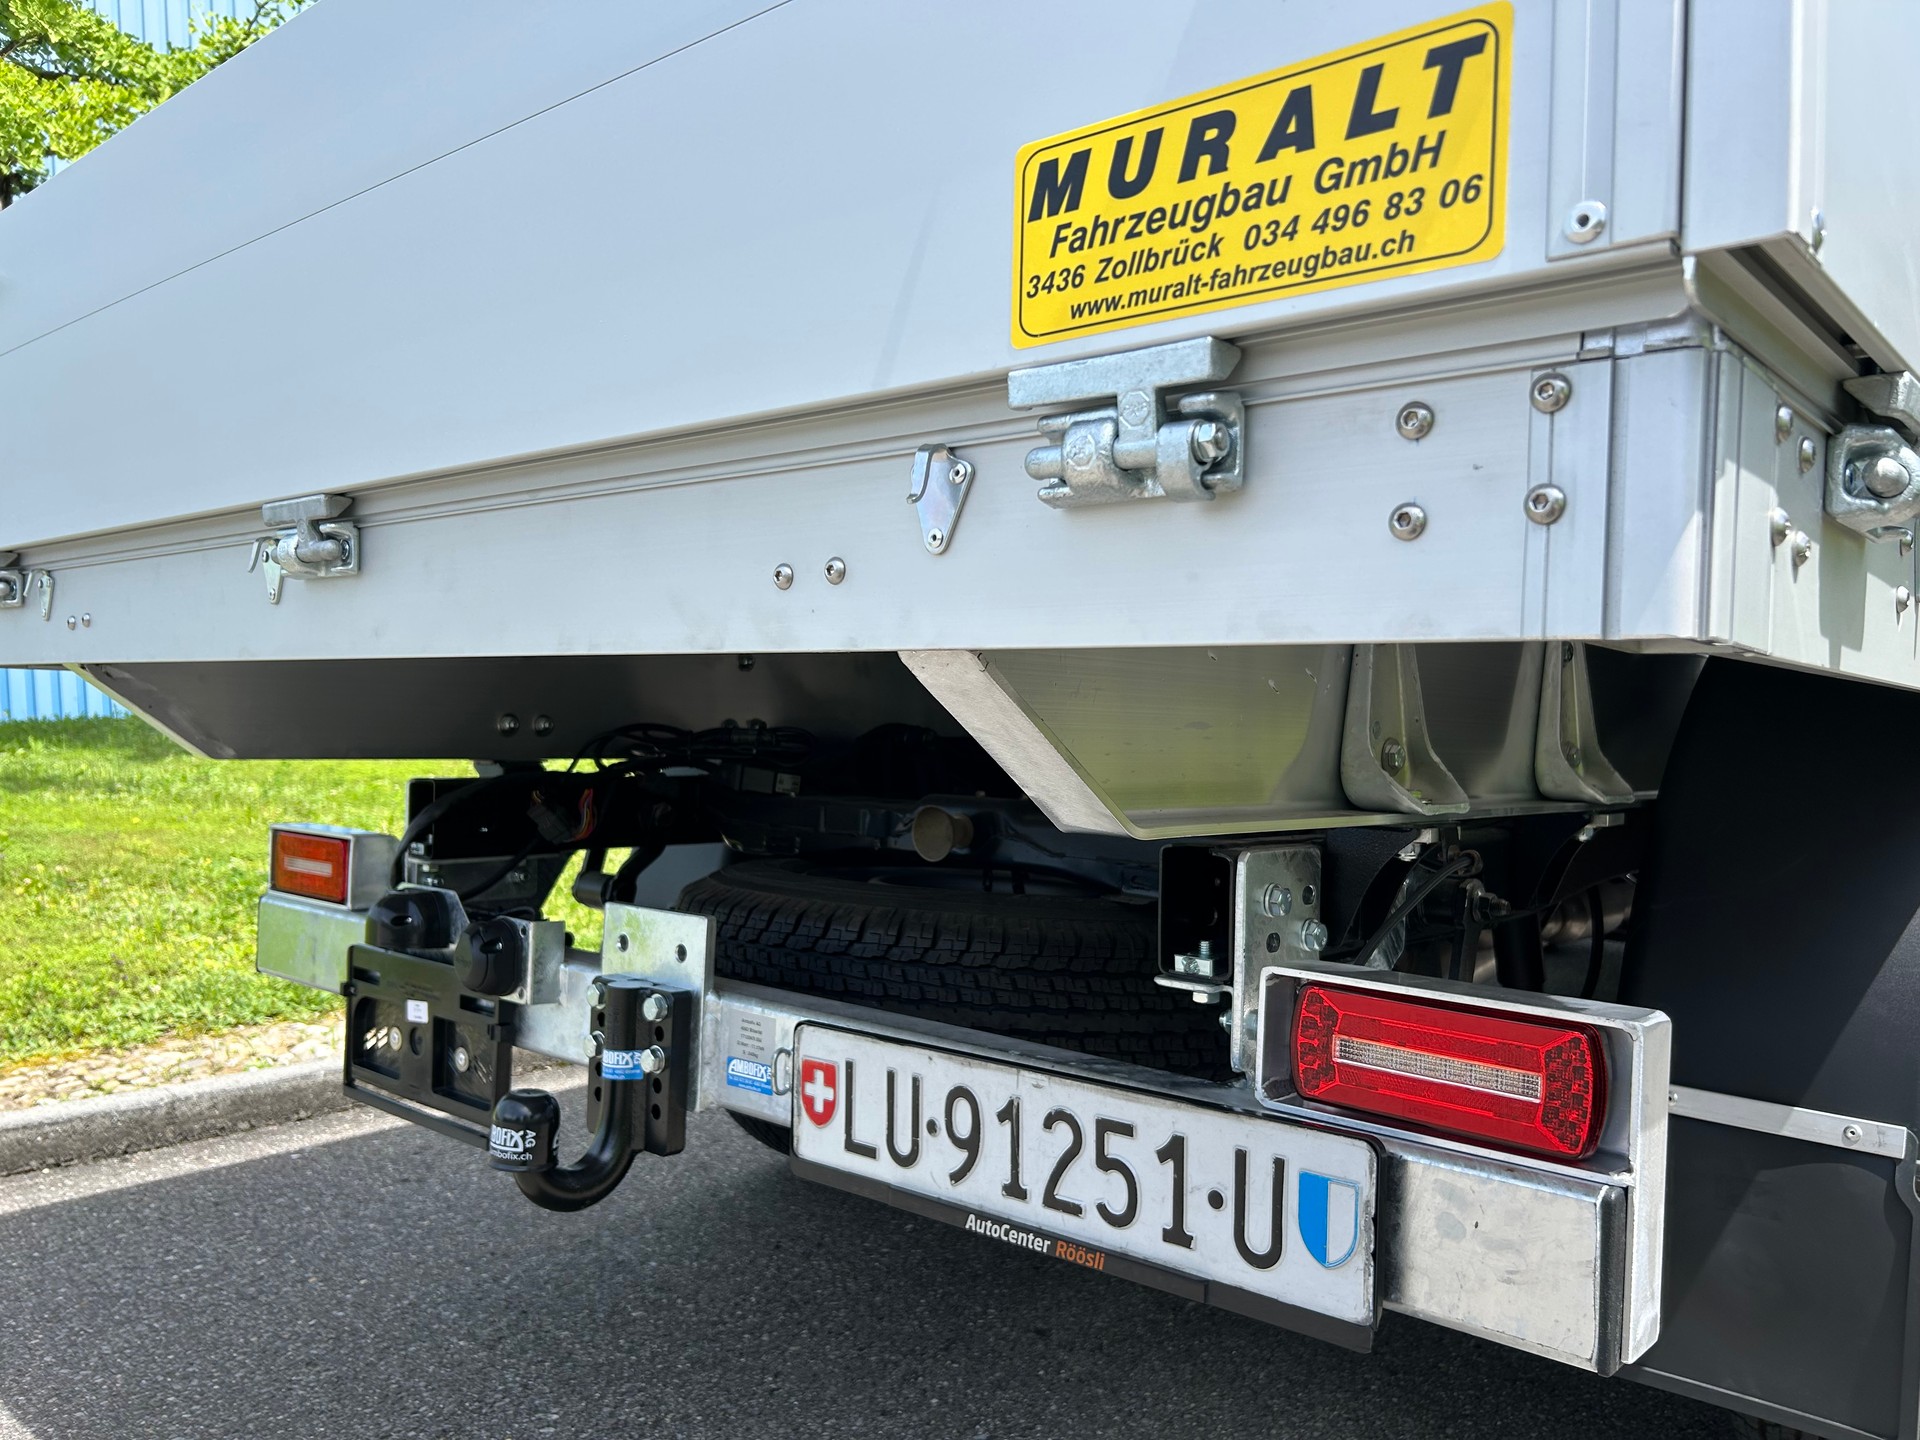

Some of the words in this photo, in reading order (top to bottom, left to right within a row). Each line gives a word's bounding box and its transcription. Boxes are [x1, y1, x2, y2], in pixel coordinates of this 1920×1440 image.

[1027, 32, 1489, 223] MURALT
[1026, 265, 1086, 298] 3436
[1094, 233, 1225, 283] Zollbrück
[1243, 215, 1300, 251] 034
[1311, 199, 1371, 235] 496
[1383, 187, 1425, 221] 83
[1439, 174, 1483, 209] 06
[1049, 175, 1292, 258] Fahrzeugbau
[1313, 130, 1447, 194] GmbH
[1070, 229, 1415, 319] www.muralt-fahrzeugbau.ch
[489, 1149, 533, 1161] mbofix.ch
[490, 1124, 525, 1149] BOFIX
[525, 1129, 536, 1148] AG
[965, 1213, 1051, 1253] AutoCenter
[1055, 1240, 1106, 1270] Röösli
